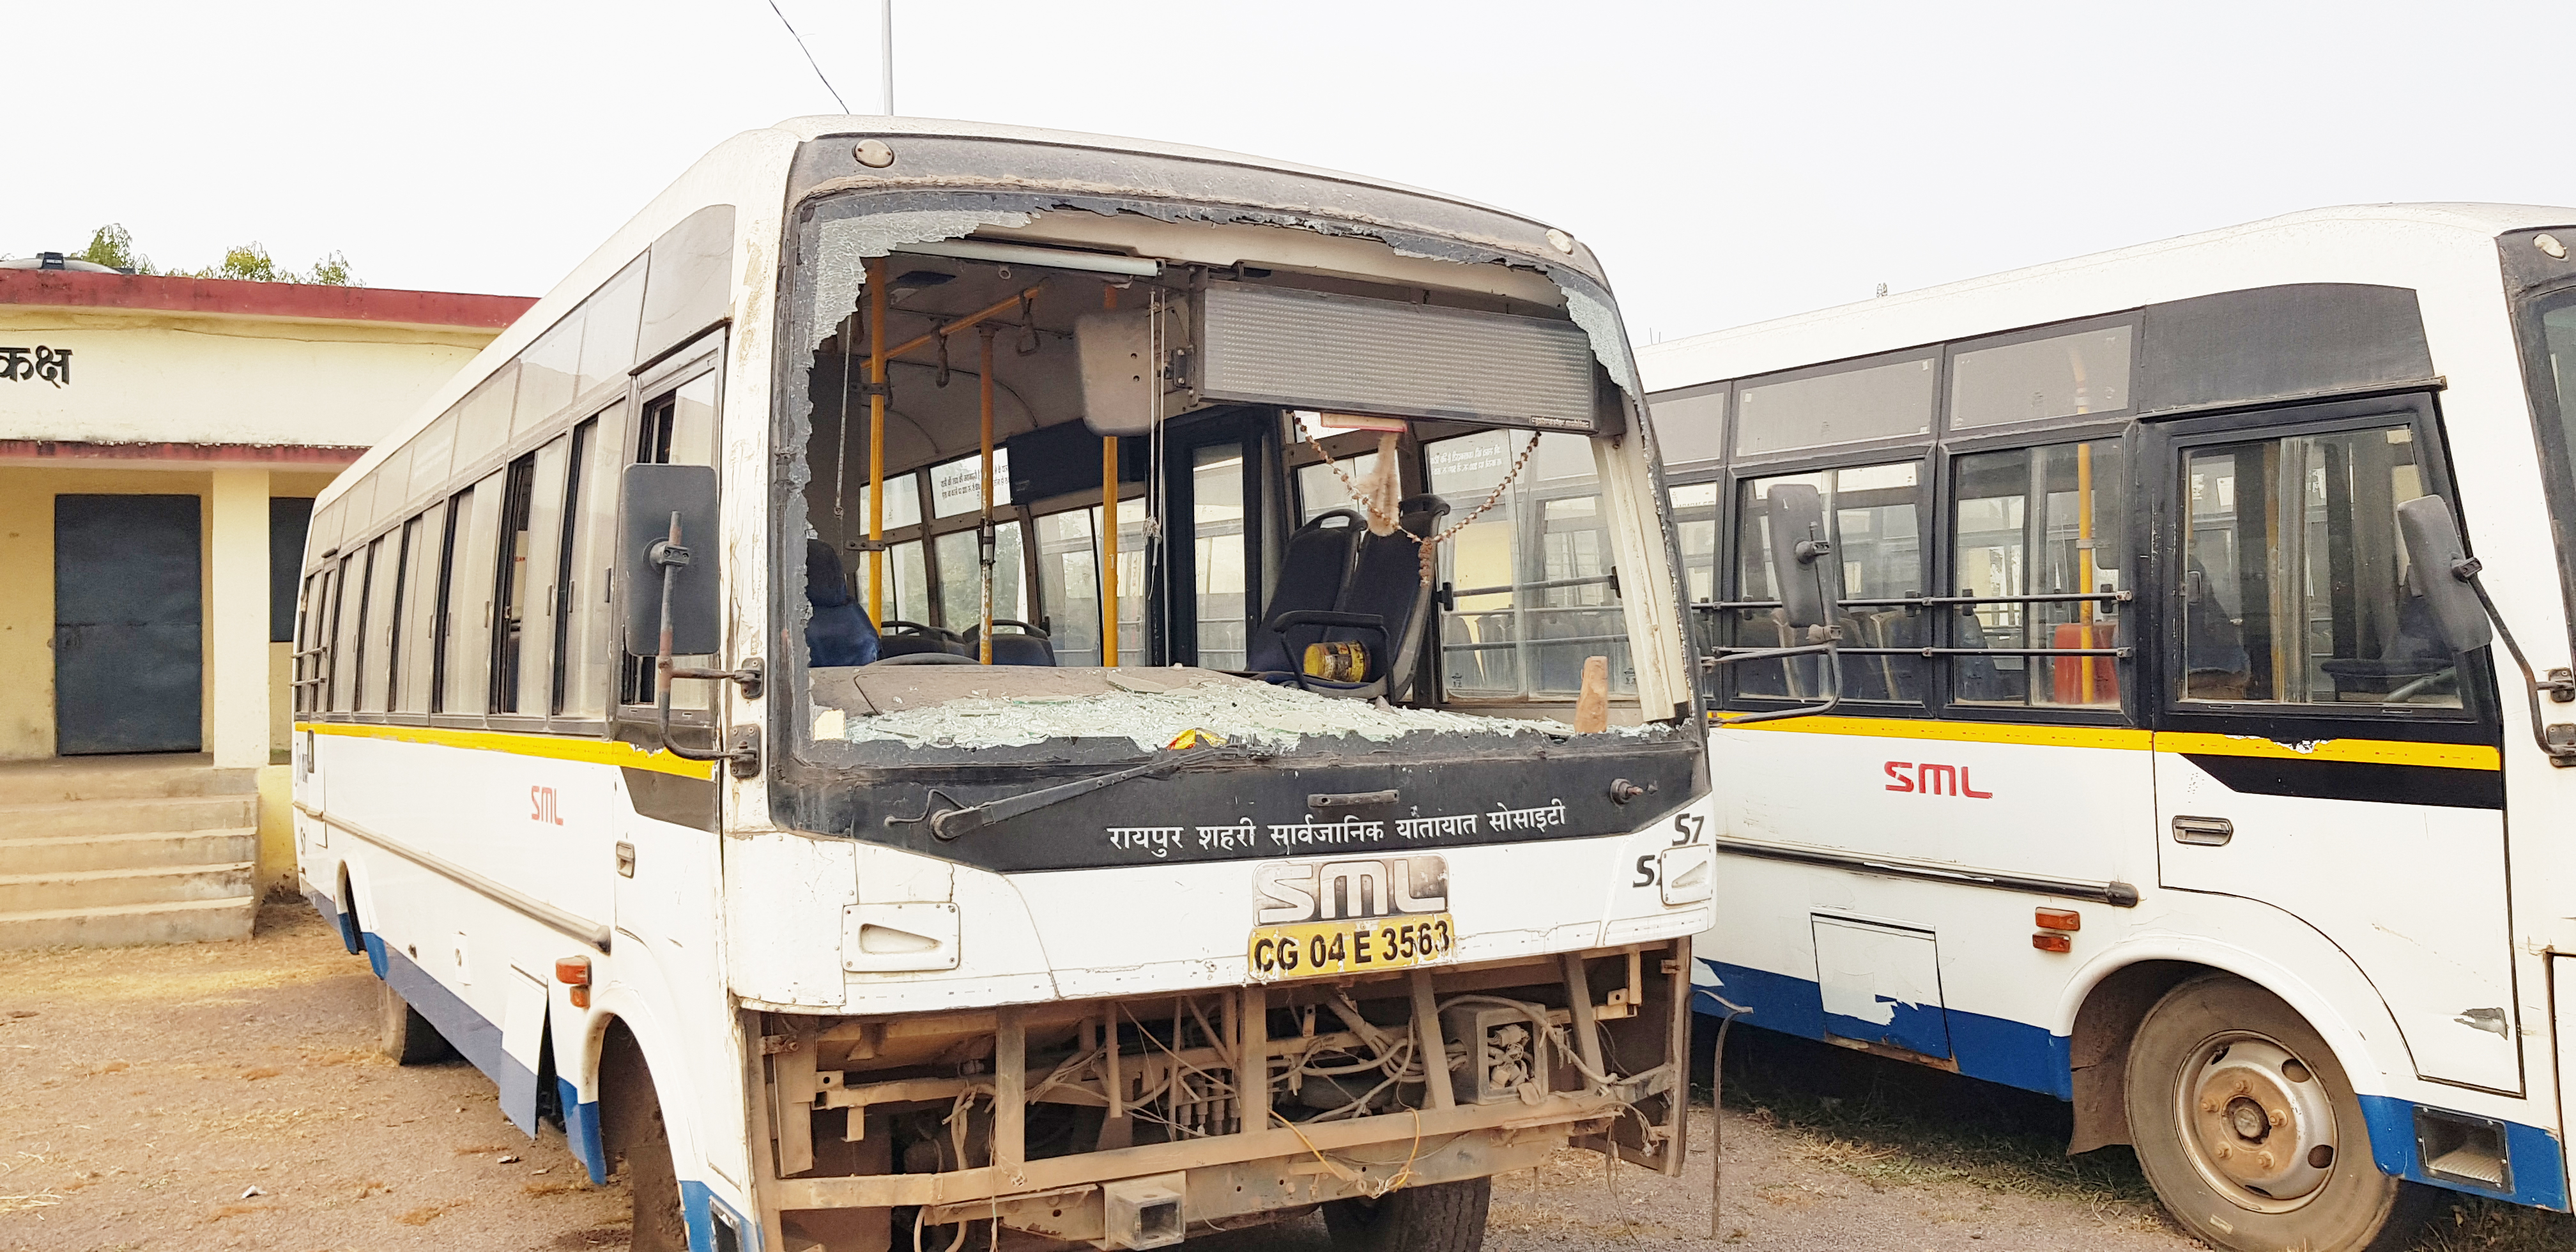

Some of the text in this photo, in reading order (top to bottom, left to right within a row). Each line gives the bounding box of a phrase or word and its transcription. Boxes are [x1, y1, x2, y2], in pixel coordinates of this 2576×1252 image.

[1884, 761, 1993, 799] SML
[531, 785, 564, 827] SML
[1105, 827, 1184, 858] रायपुर
[1195, 817, 1257, 851] शहरी
[1485, 798, 1566, 832] सोसाइटी
[1672, 813, 1705, 846] S7
[1257, 859, 1446, 924] SML
[1632, 855, 1662, 888] S
[1254, 920, 1450, 972] CG 04 E 3563
